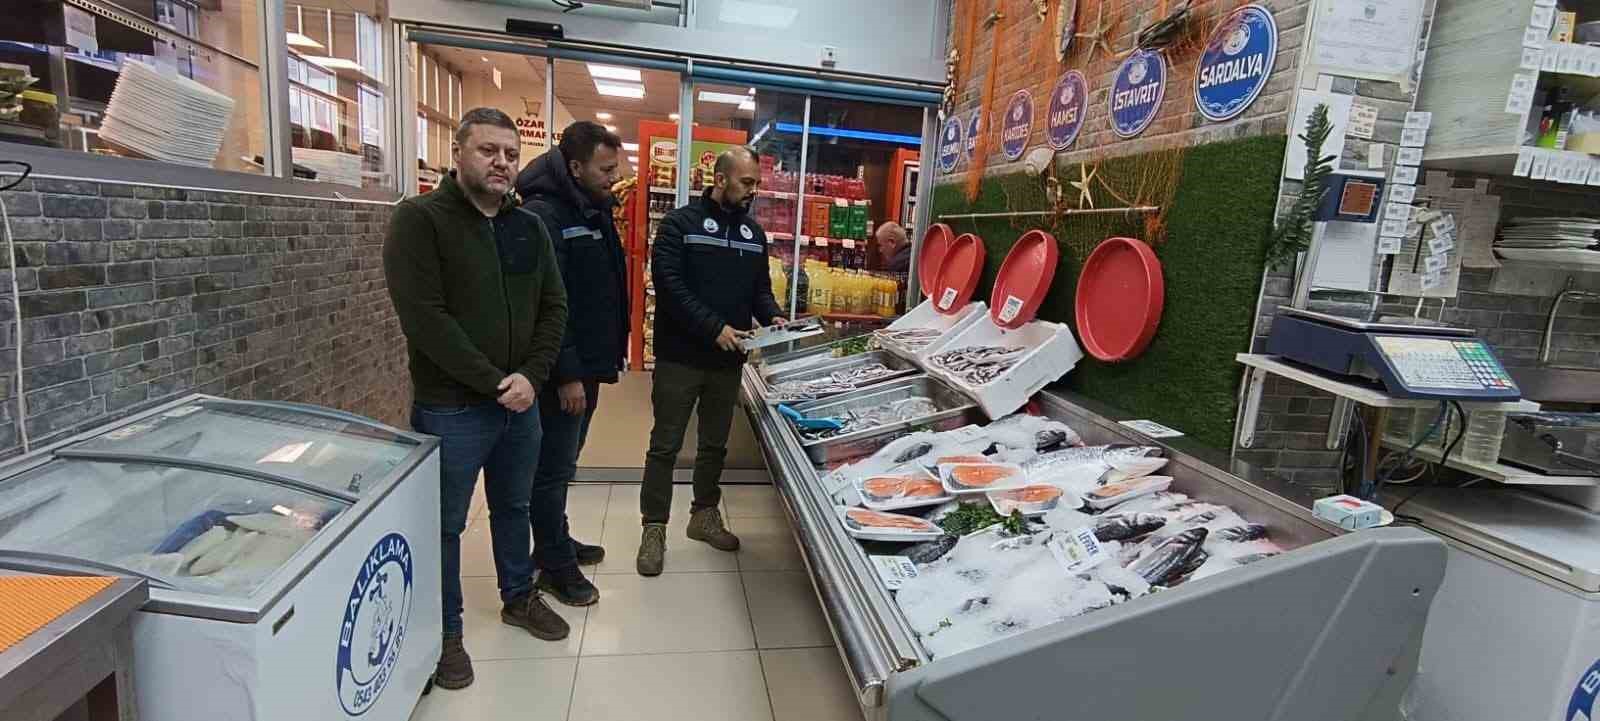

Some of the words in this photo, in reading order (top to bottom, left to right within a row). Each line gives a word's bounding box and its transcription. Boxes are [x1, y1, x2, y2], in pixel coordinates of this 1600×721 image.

[1199, 53, 1264, 89] SARDALYA
[1113, 78, 1160, 112] İSTAVRİT
[516, 117, 545, 129] ÖZAR
[341, 538, 410, 648] BALIKLAMA
